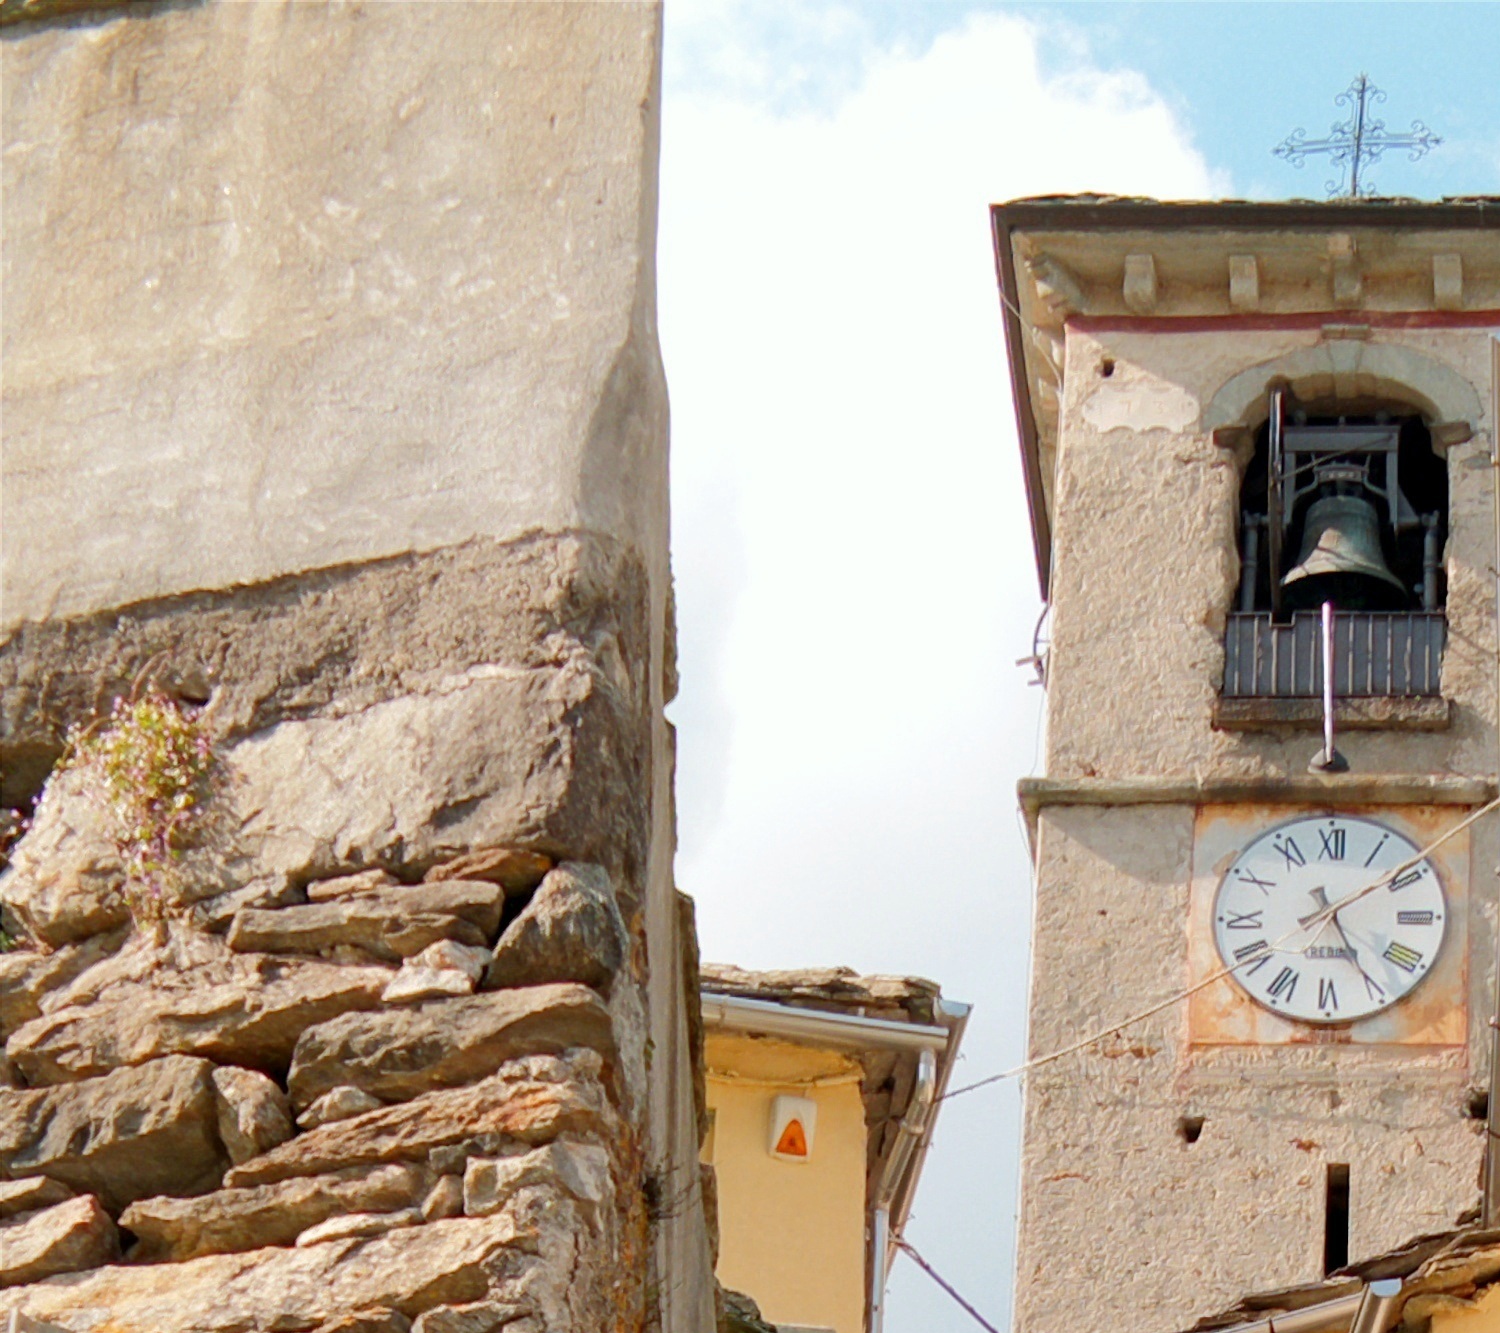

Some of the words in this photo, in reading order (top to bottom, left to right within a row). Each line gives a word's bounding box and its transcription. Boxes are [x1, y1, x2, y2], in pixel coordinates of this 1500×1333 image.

[1273, 836, 1306, 873] XI
[1318, 829, 1346, 861] XII
[1238, 868, 1276, 896] X
[1318, 978, 1338, 1010] VI
